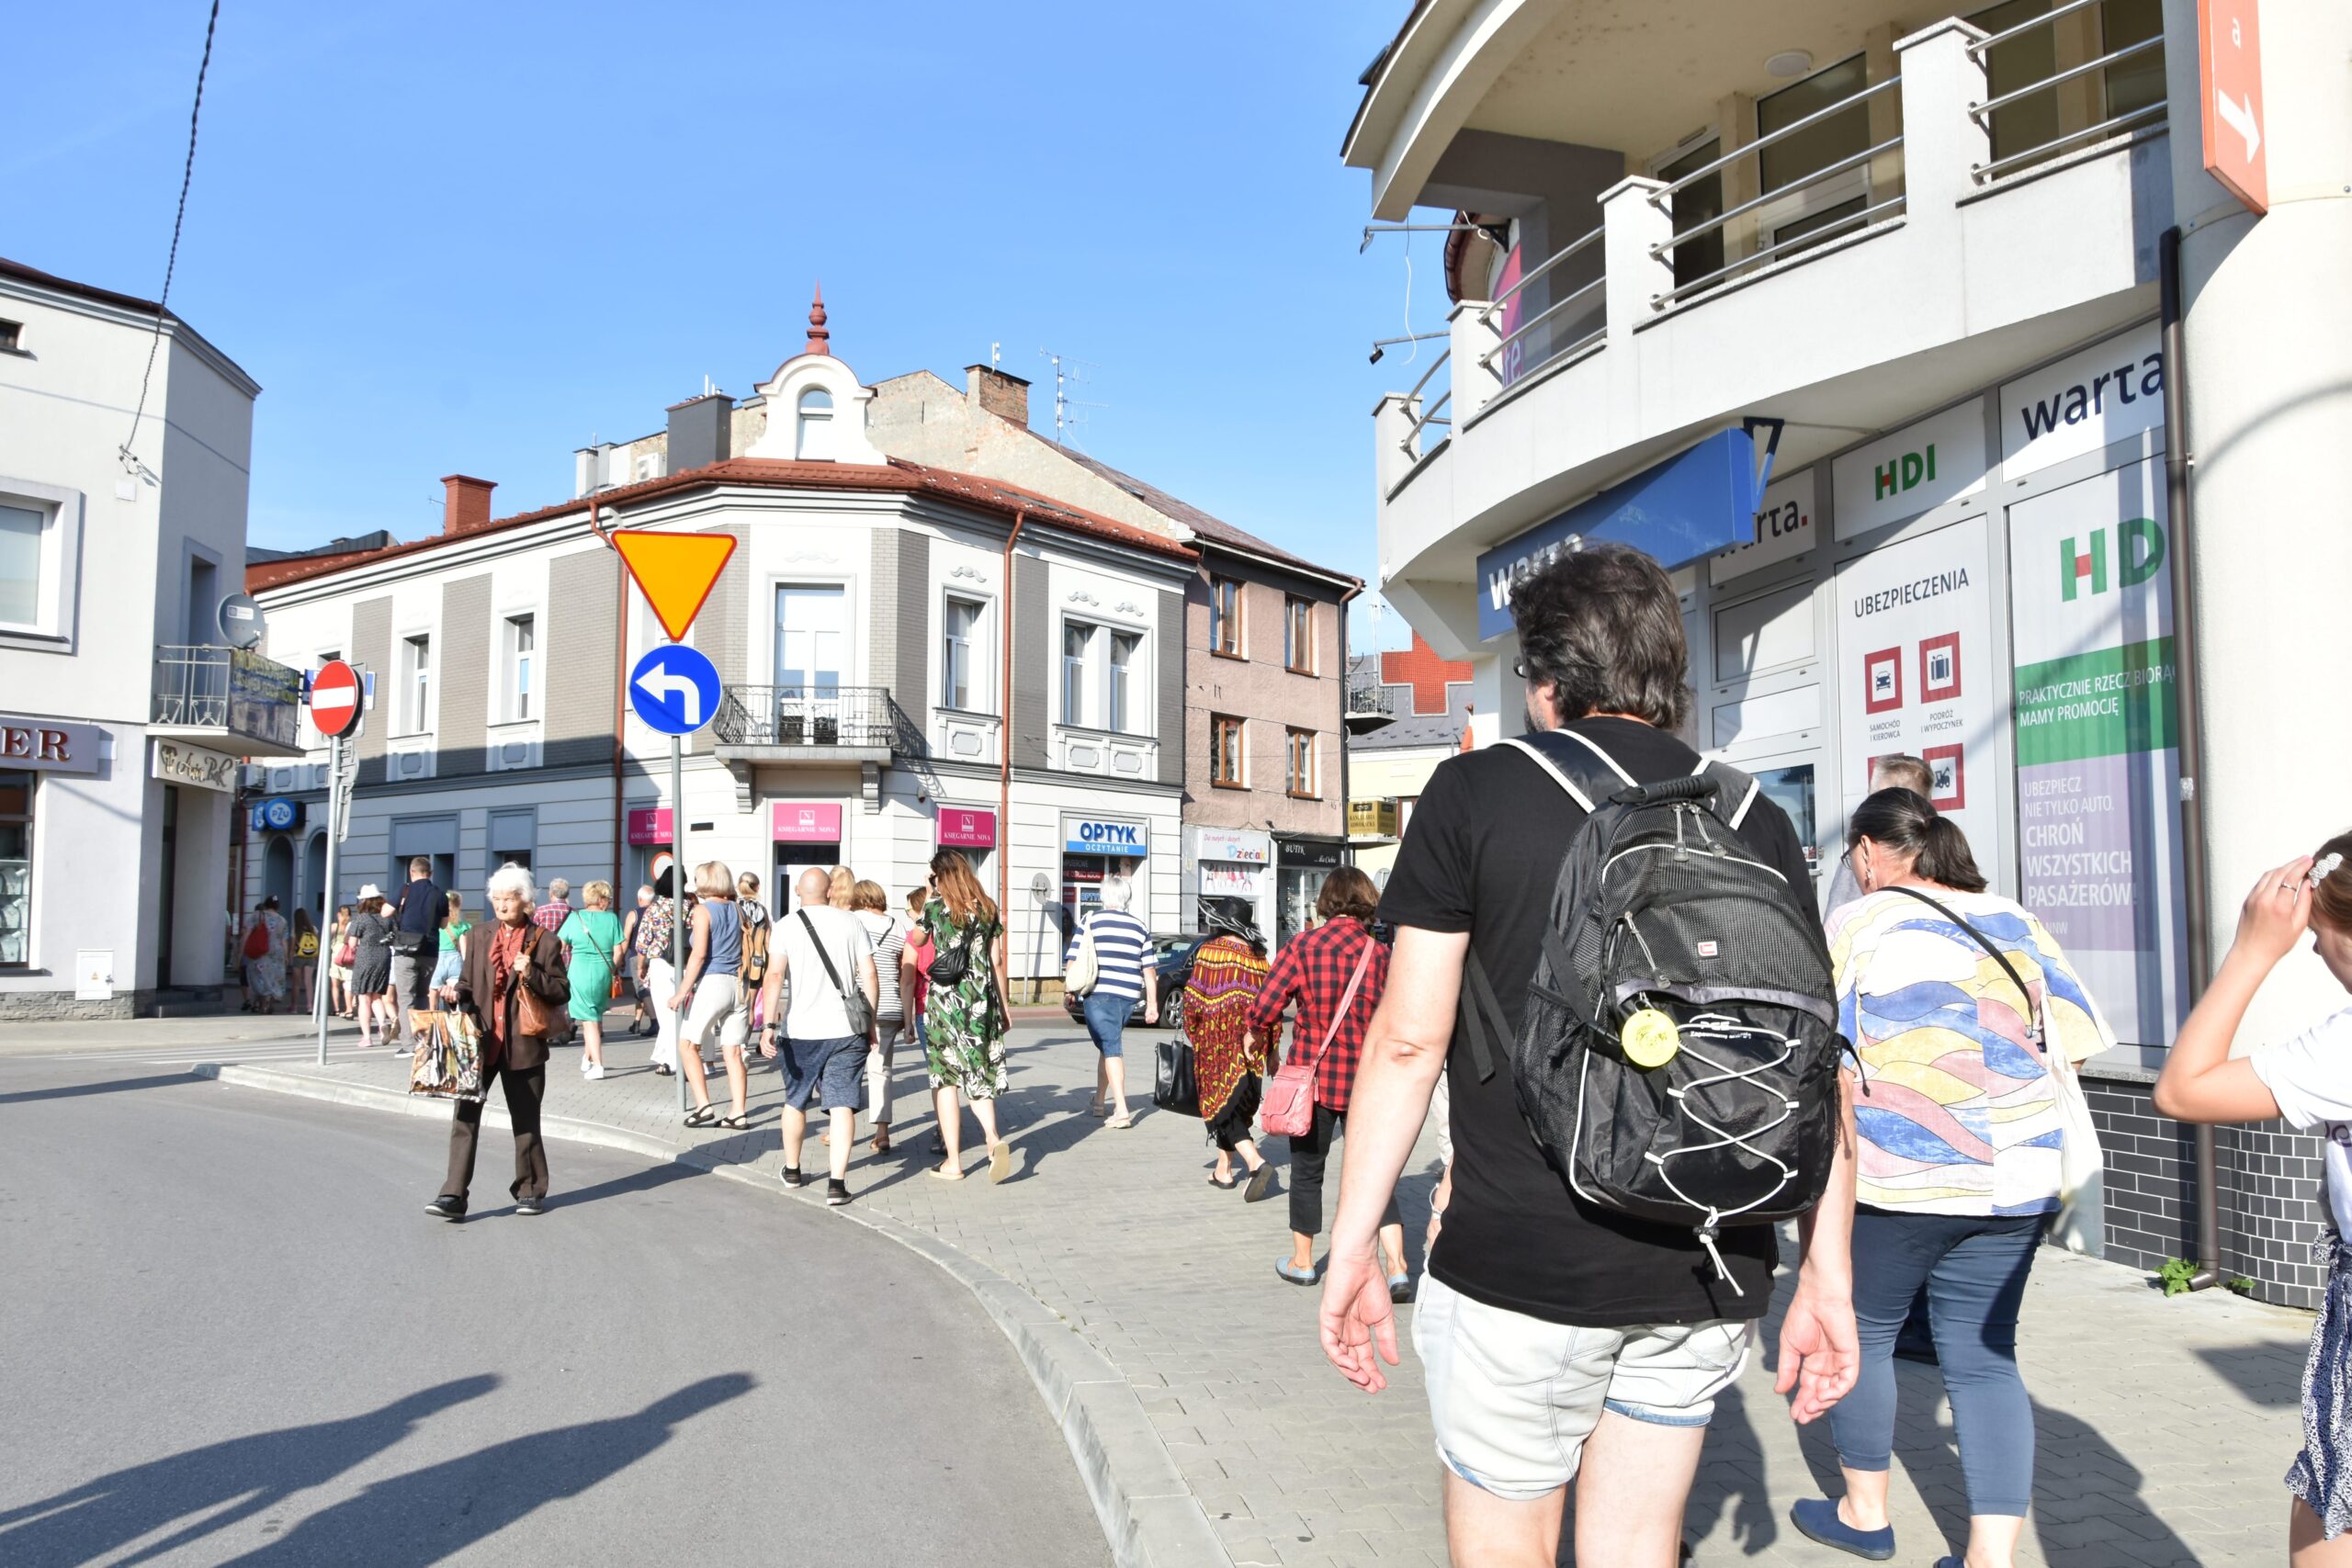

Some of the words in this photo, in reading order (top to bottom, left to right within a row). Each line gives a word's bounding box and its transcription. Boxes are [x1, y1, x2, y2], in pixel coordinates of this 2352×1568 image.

[1874, 444, 1936, 502] HDI
[2060, 517, 2165, 603] HD
[1854, 567, 1970, 618] UBEZPIECZENIA
[2018, 678, 2092, 705] PRAKTYCZNIE
[2095, 671, 2132, 693] RZECZ
[2134, 663, 2176, 685] BIORĄ
[1929, 709, 1954, 721] PODRÓŻ
[2020, 708, 2054, 728] MAMY
[2057, 696, 2120, 722] PROMOCJĘ
[1870, 719, 1901, 732] SAMOCHÓD
[1873, 730, 1901, 741] KIEROWCA
[1924, 719, 1963, 732] WYPOCZYNEK
[2024, 776, 2082, 797] UBEZPIECZ
[271, 807, 289, 820] PZU
[2024, 802, 2042, 818] NIE
[2044, 798, 2079, 816] TYLKO
[2081, 795, 2115, 813] AUTO.
[1080, 822, 1136, 844] OPTYK
[2026, 817, 2084, 848] CHROŃ
[1085, 843, 1129, 853] OCZYTANIE
[1227, 844, 1265, 861] Dzieciak
[2026, 851, 2132, 877] WSZYSTKICH
